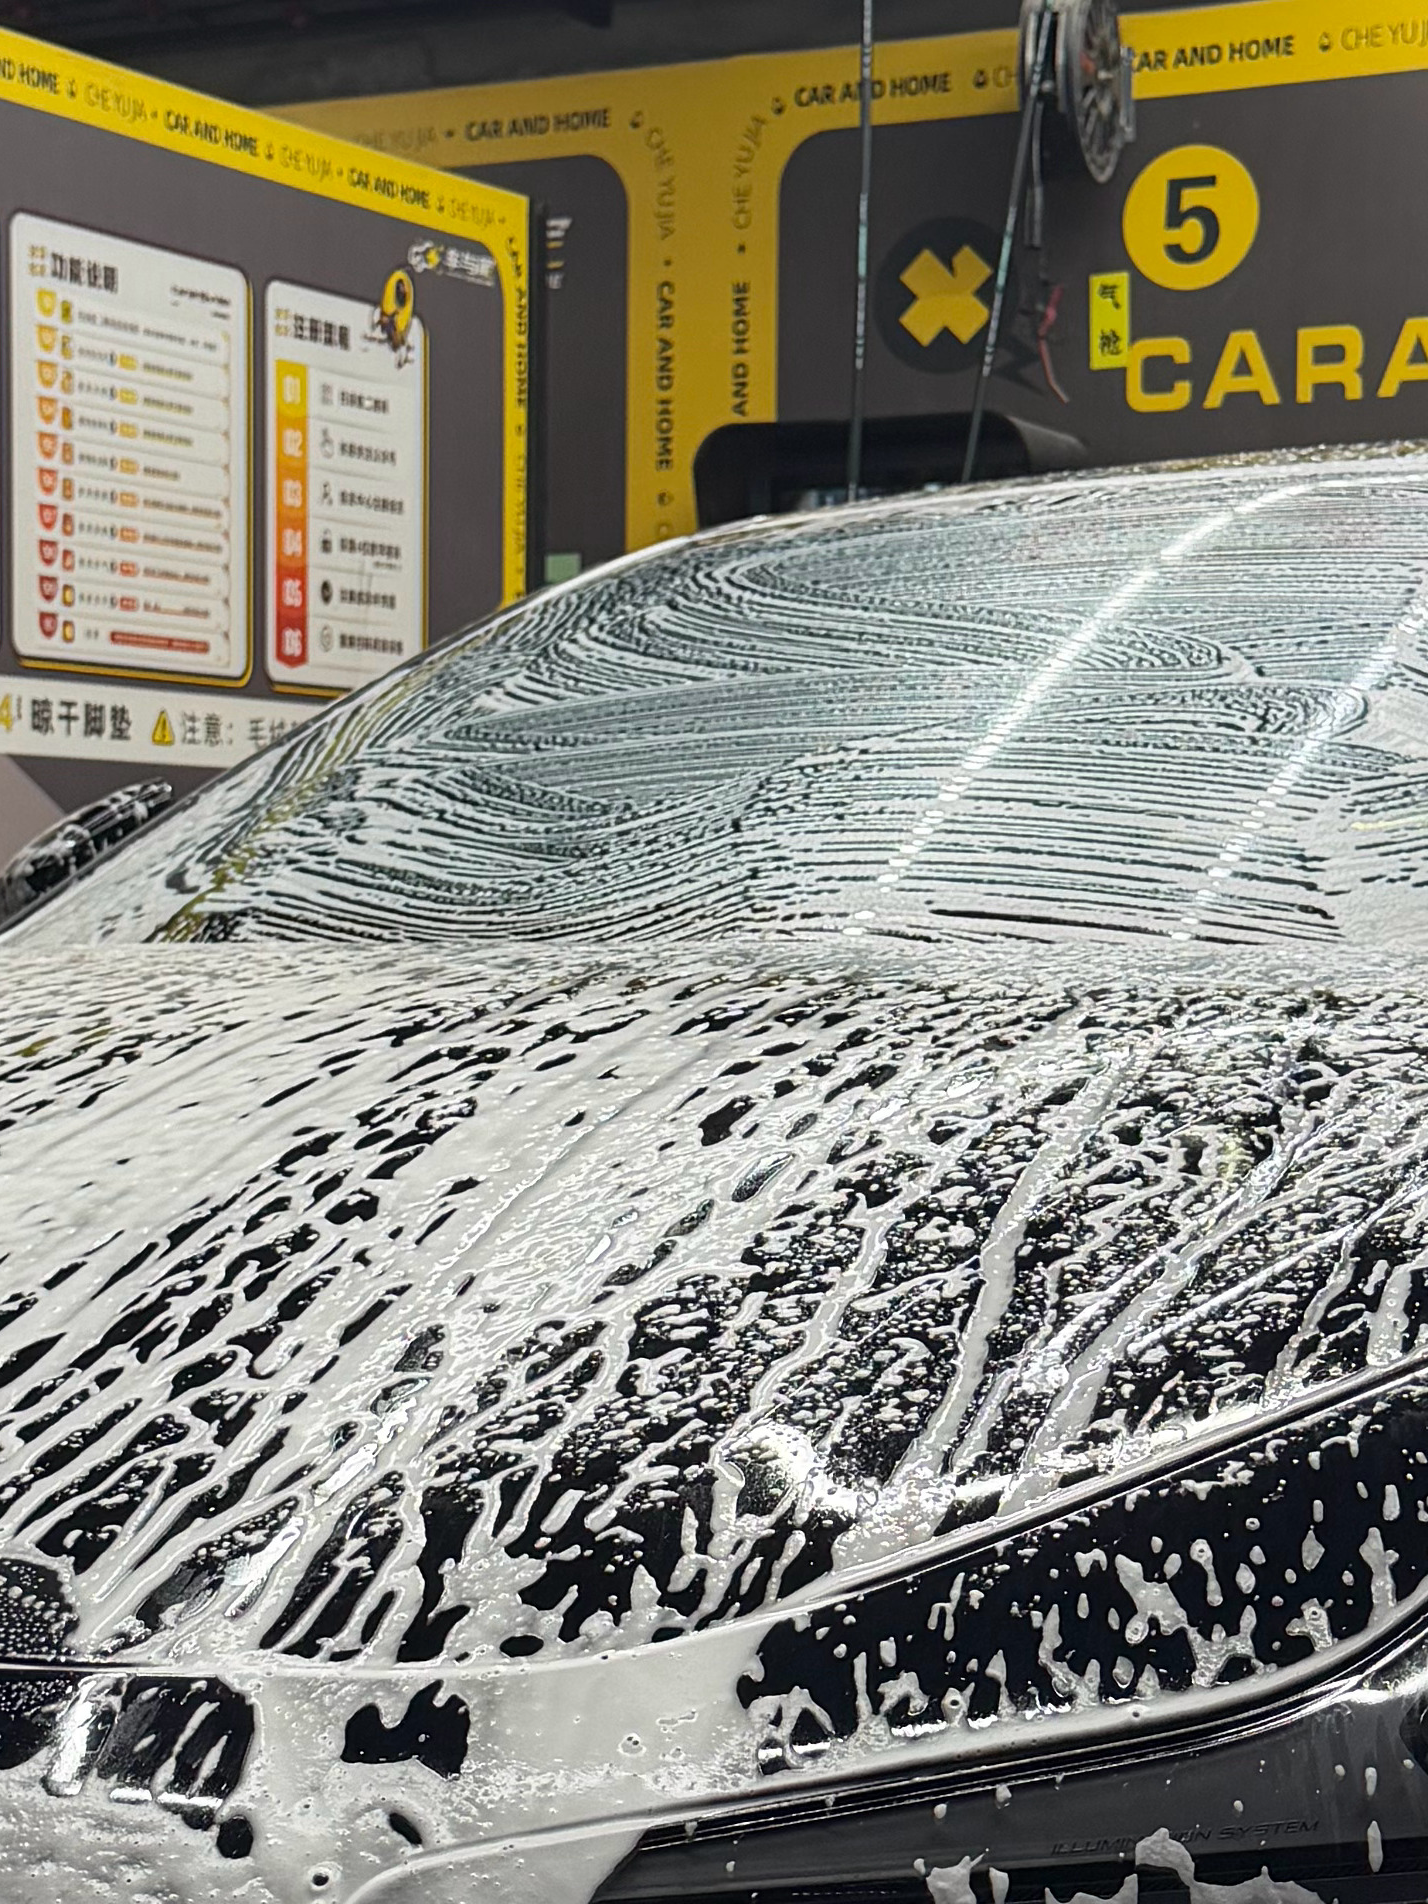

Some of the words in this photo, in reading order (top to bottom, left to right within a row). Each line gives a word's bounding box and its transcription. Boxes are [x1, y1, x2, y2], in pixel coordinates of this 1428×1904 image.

[1130, 51, 1168, 73] AR
[1173, 45, 1224, 69] AND
[1229, 35, 1295, 62] HOME
[18, 63, 60, 95] HOME
[794, 81, 837, 107] CAR
[890, 73, 952, 102] HOME
[164, 108, 191, 135] CAR
[193, 119, 220, 145] AND
[224, 129, 259, 157] HOME
[465, 121, 502, 142] CAR
[508, 115, 551, 137] AND
[553, 108, 612, 134] HOME
[1162, 175, 1222, 264] 5
[657, 280, 675, 330] CAR
[732, 280, 751, 355] HOME
[656, 337, 675, 392] AND
[731, 362, 751, 417] AND
[655, 399, 673, 471] HOME
[31, 698, 132, 741] 晾干脚垫
